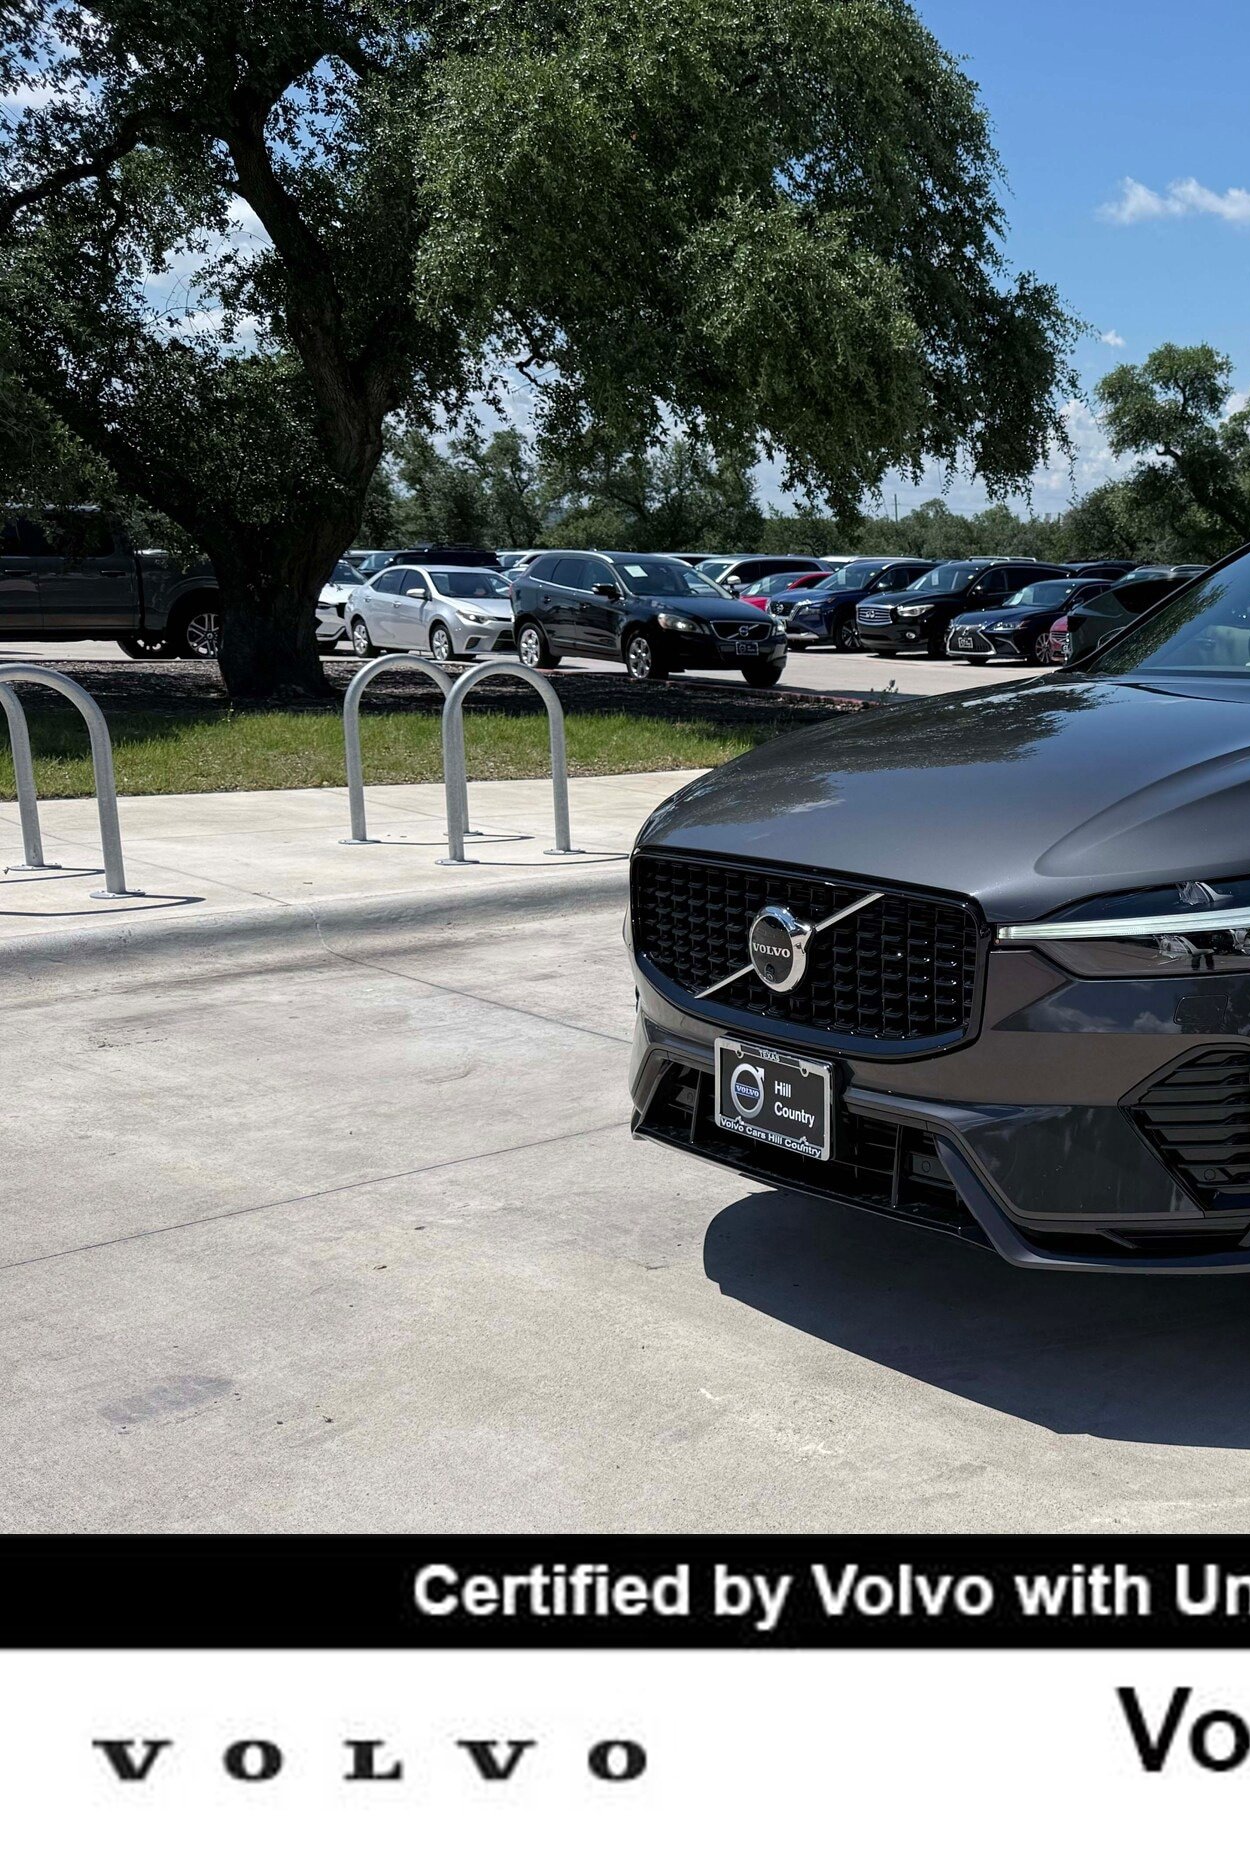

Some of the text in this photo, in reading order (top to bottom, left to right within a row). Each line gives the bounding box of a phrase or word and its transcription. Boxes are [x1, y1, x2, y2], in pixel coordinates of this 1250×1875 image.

[752, 942, 791, 958] VOLVO
[759, 1050, 780, 1062] TEXAS
[735, 1083, 760, 1098] VOLVO
[774, 1080, 792, 1098] Hill
[774, 1101, 815, 1128] Country
[720, 1117, 822, 1158] Volvo Cars Hill Country
